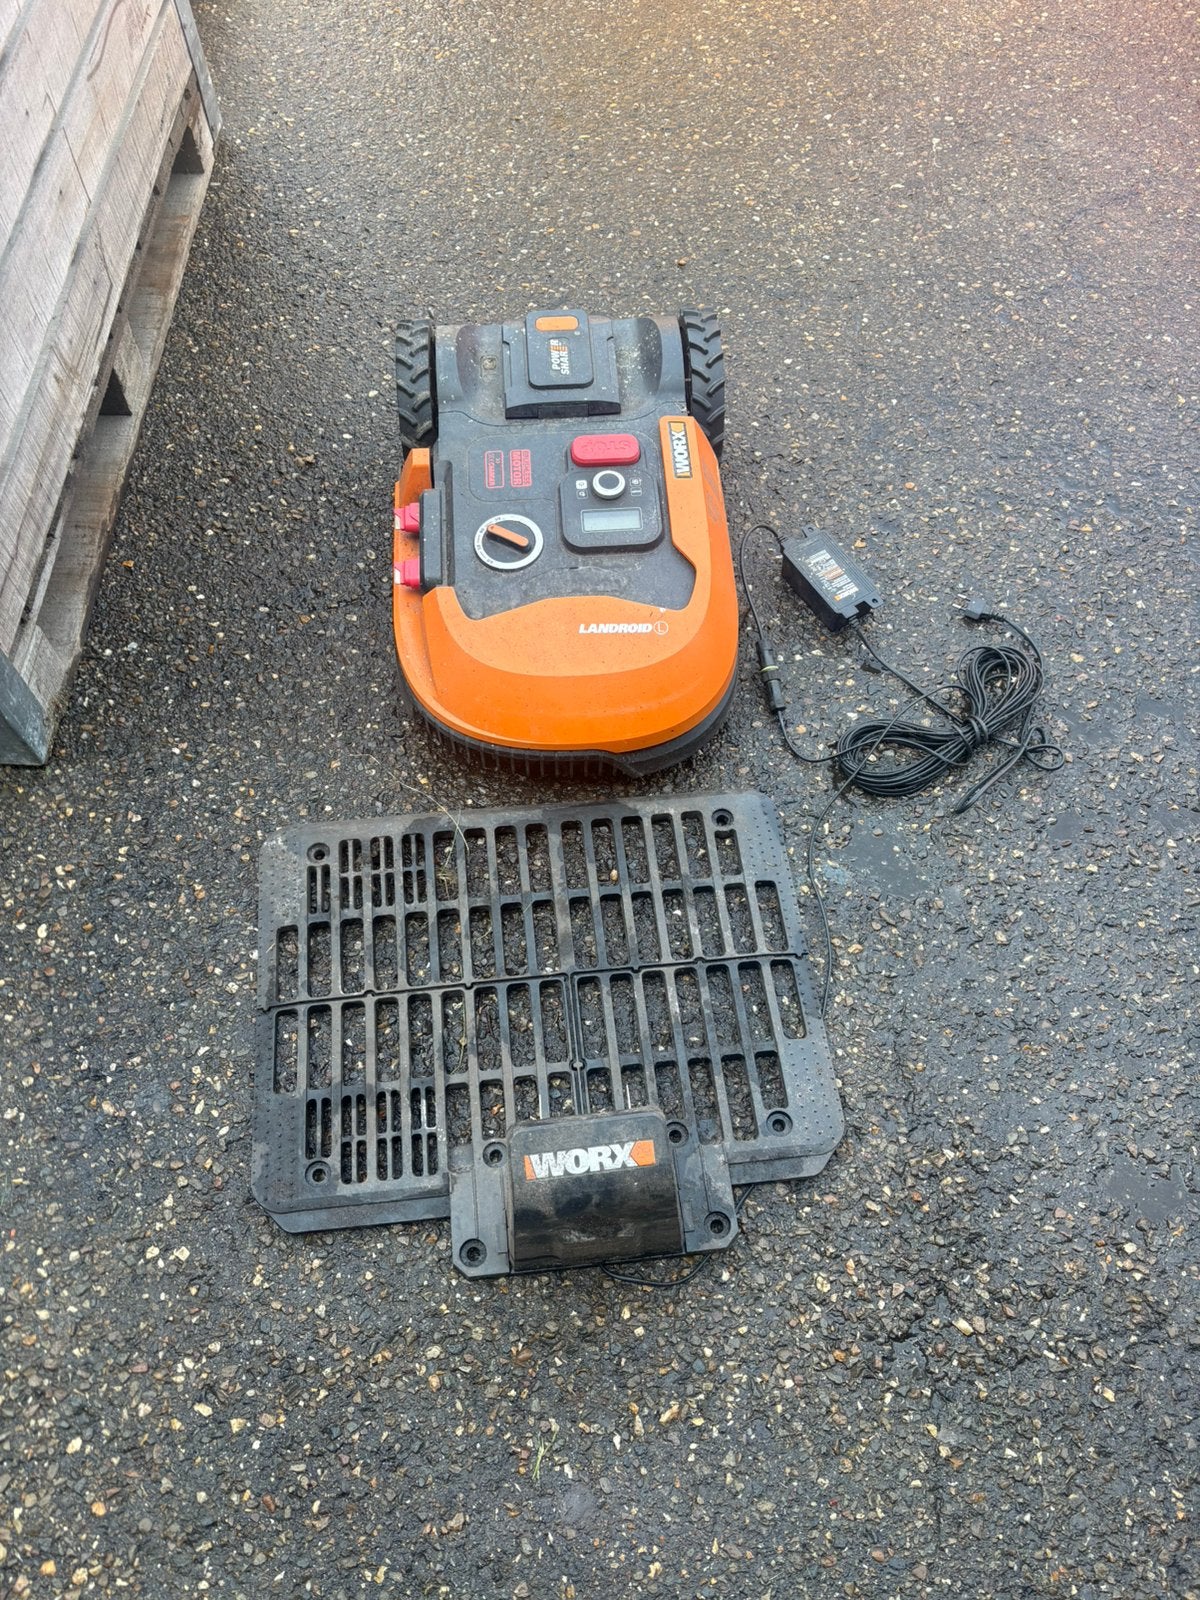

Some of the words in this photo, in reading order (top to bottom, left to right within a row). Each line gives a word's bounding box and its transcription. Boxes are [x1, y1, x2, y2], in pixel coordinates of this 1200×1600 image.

[550, 339, 561, 370] POWER
[560, 346, 570, 375] SHARE
[511, 450, 522, 486] MOTOR
[672, 431, 690, 475] WORX
[579, 623, 653, 634] LANDROID
[530, 1141, 638, 1178] WORX
